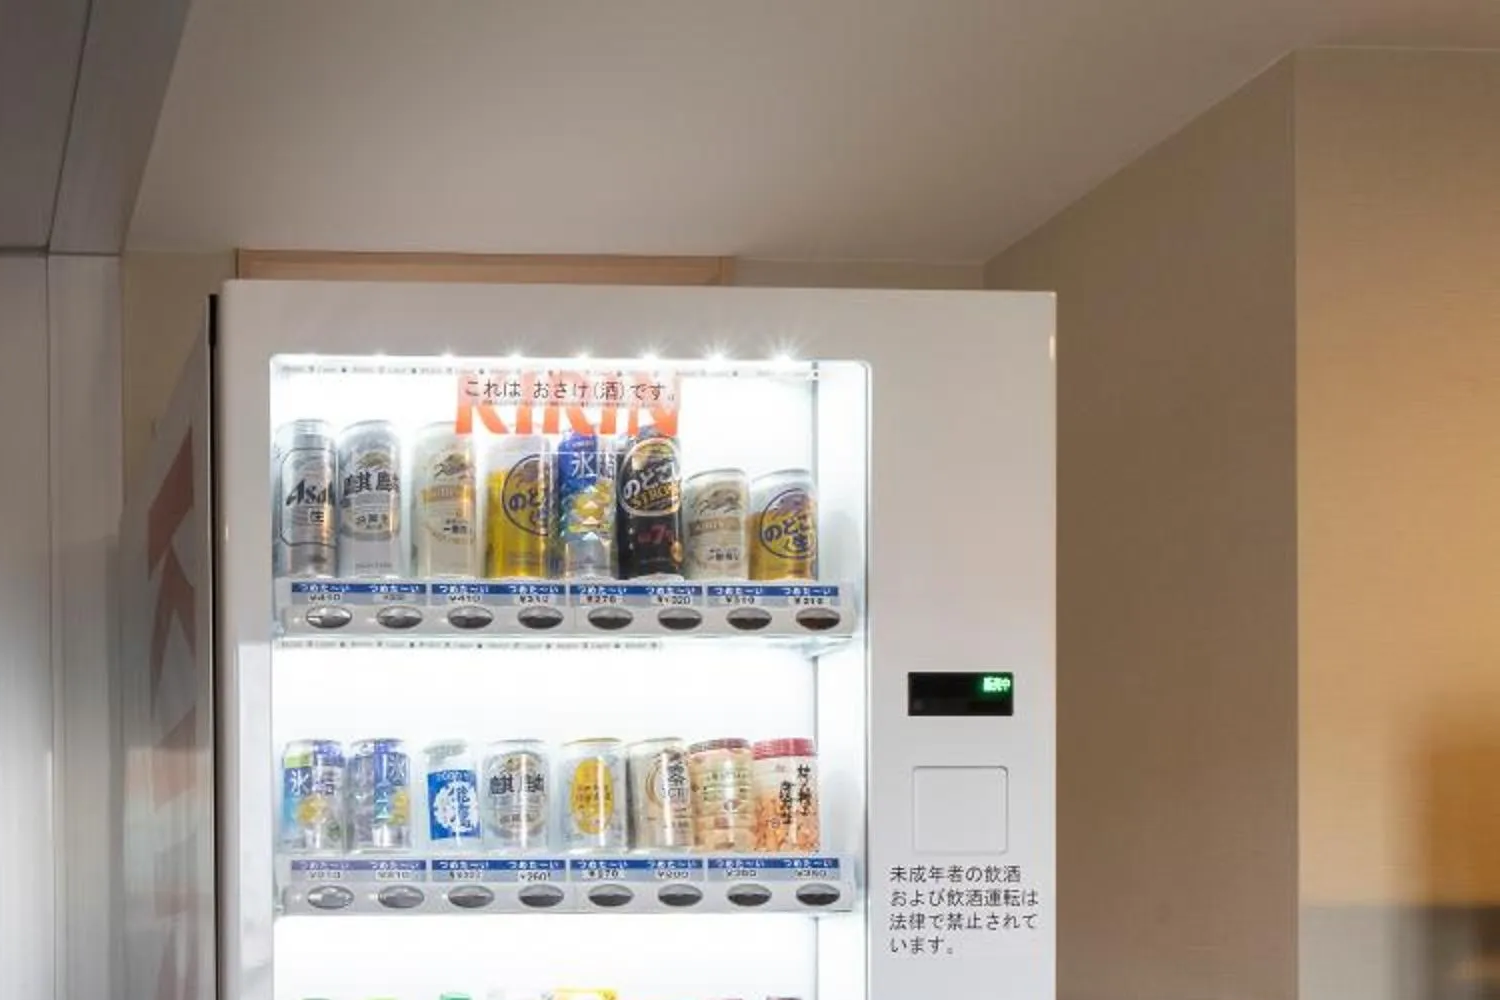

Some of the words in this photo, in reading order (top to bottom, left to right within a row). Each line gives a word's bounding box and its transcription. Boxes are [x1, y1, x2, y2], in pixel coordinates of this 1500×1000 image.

[465, 379, 521, 397] これは
[889, 864, 1022, 883] 未成年者の飲酒
[889, 889, 1039, 908] および飲酒運転は
[889, 913, 1039, 932] 法律で禁止されて
[889, 937, 954, 955] います。
